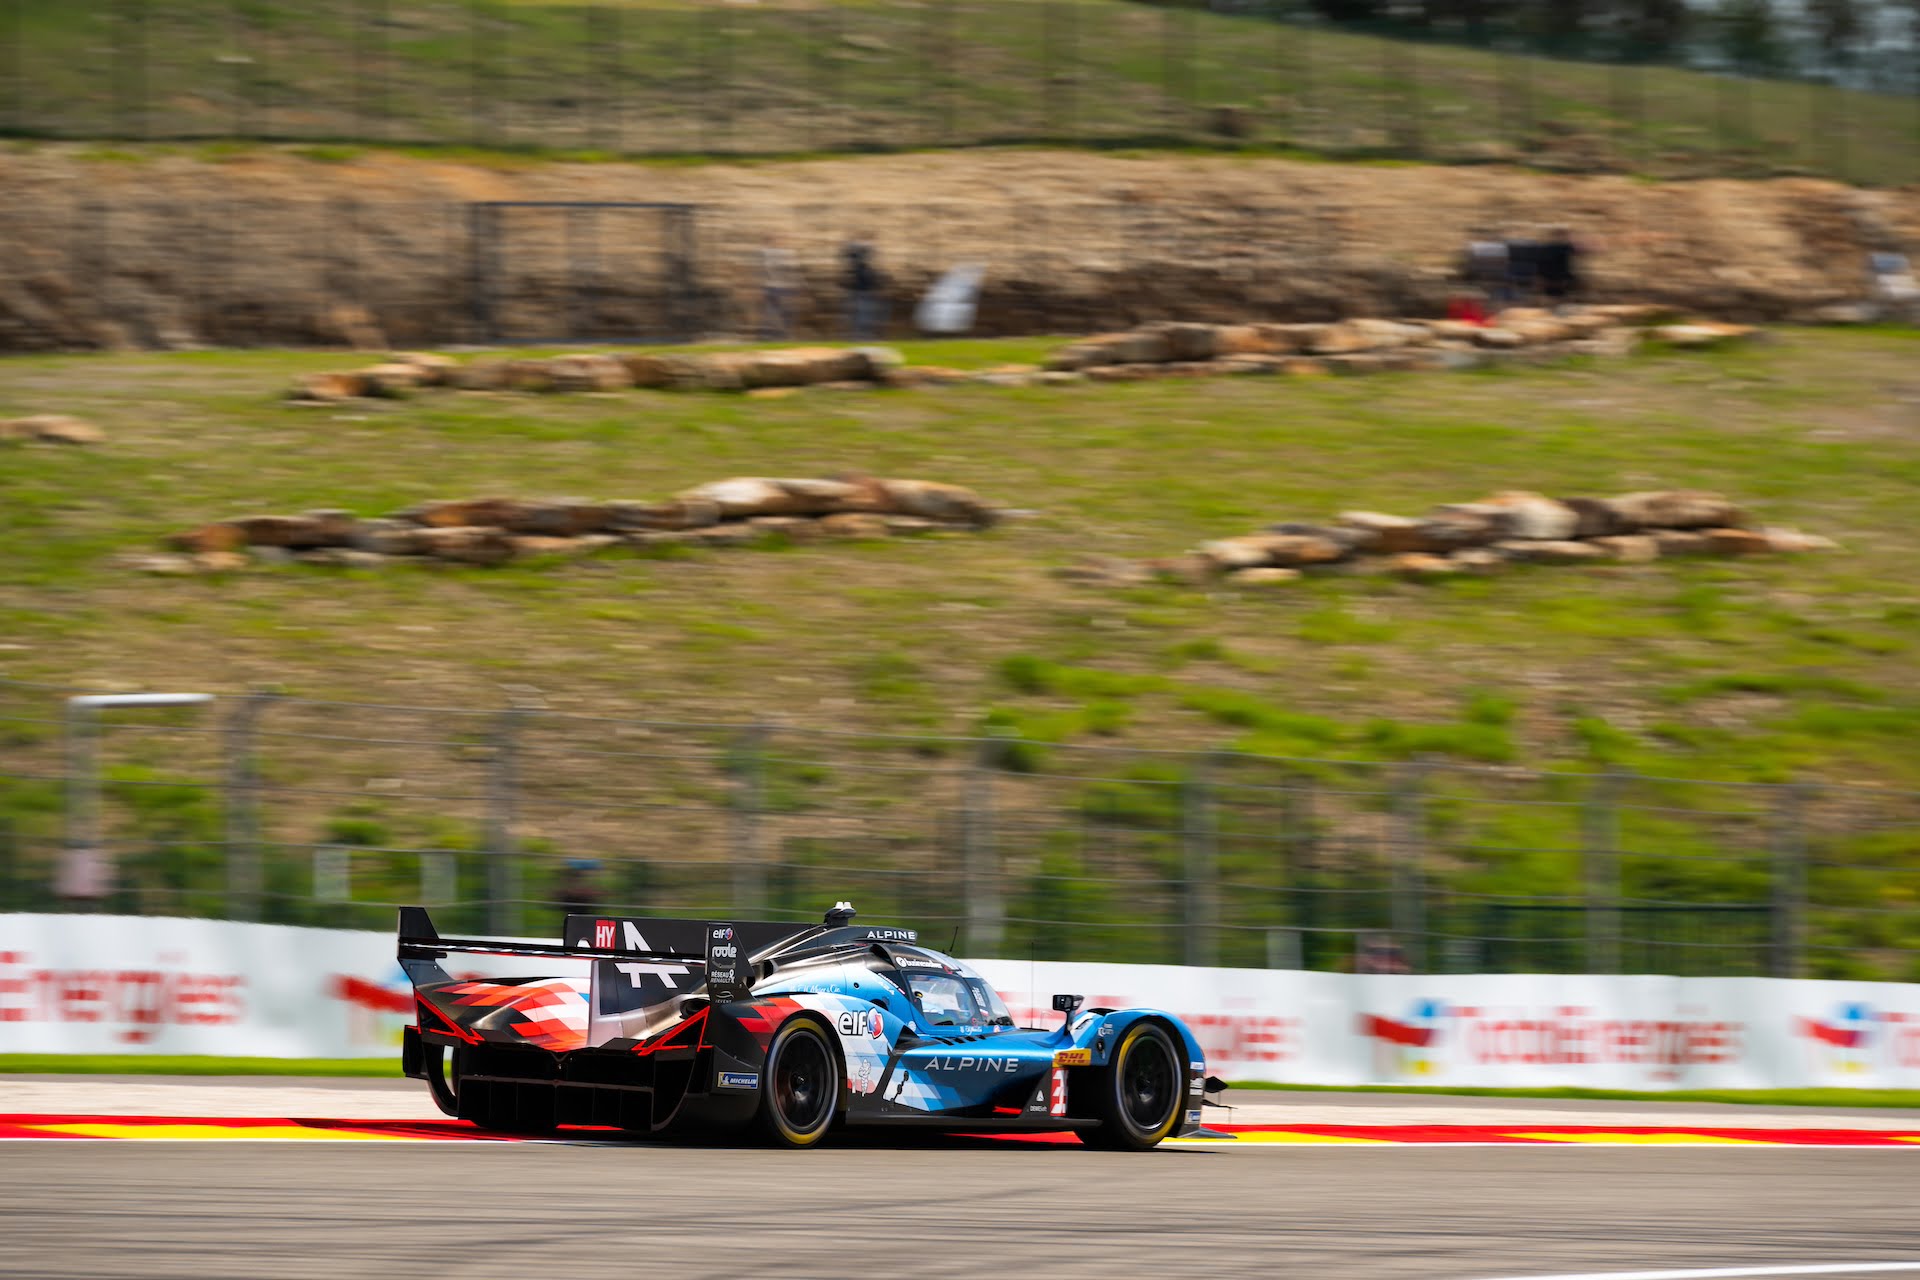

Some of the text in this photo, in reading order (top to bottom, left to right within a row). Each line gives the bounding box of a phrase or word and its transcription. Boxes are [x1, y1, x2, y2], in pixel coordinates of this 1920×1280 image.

[595, 925, 615, 948] HY
[867, 930, 916, 940] ALPINE
[838, 1011, 867, 1036] elf
[924, 1056, 1019, 1073] ALPINE
[1057, 1052, 1085, 1063] DHL
